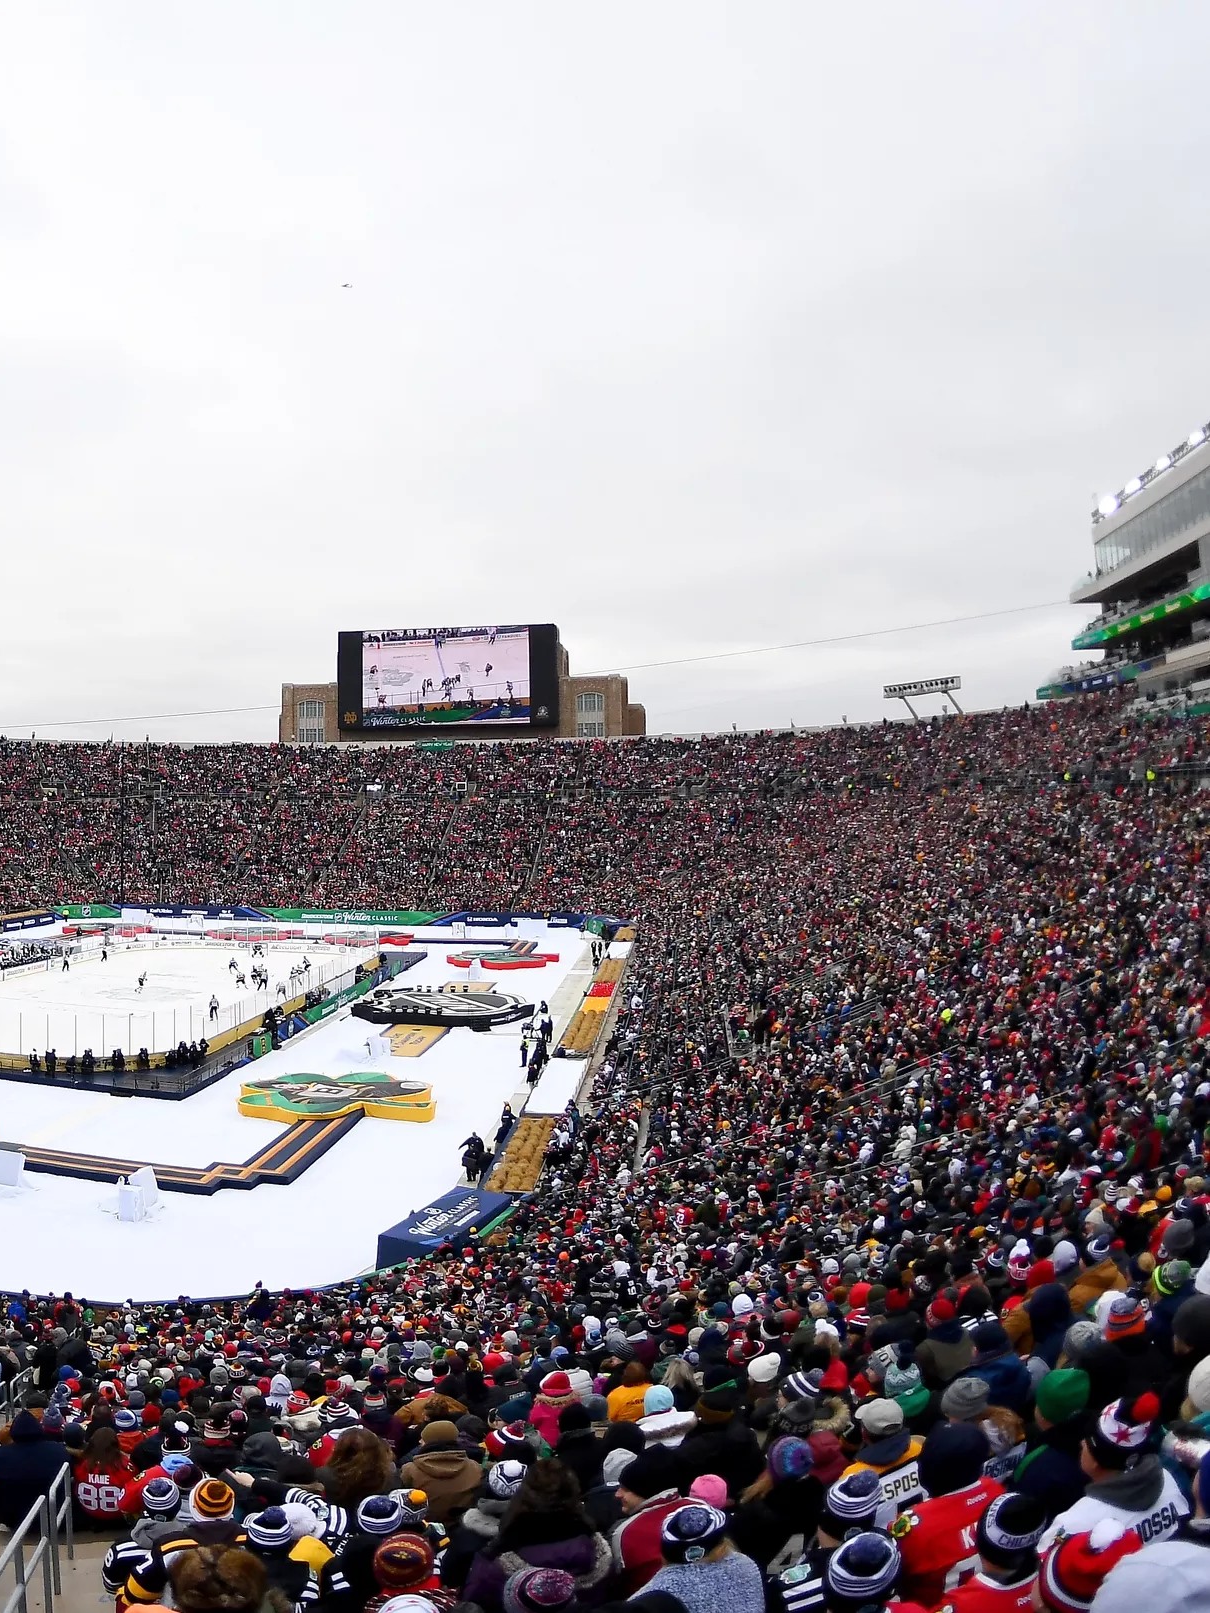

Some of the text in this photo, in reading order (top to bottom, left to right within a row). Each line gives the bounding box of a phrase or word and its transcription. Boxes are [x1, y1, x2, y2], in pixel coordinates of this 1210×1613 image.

[370, 714, 400, 726] Winter
[400, 716, 426, 724] CLASSIC
[342, 912, 372, 923] Winter
[408, 1213, 448, 1237] Winter
[449, 1195, 479, 1214] CLASSIC
[88, 1473, 111, 1485] KANE
[77, 1482, 121, 1512] 88
